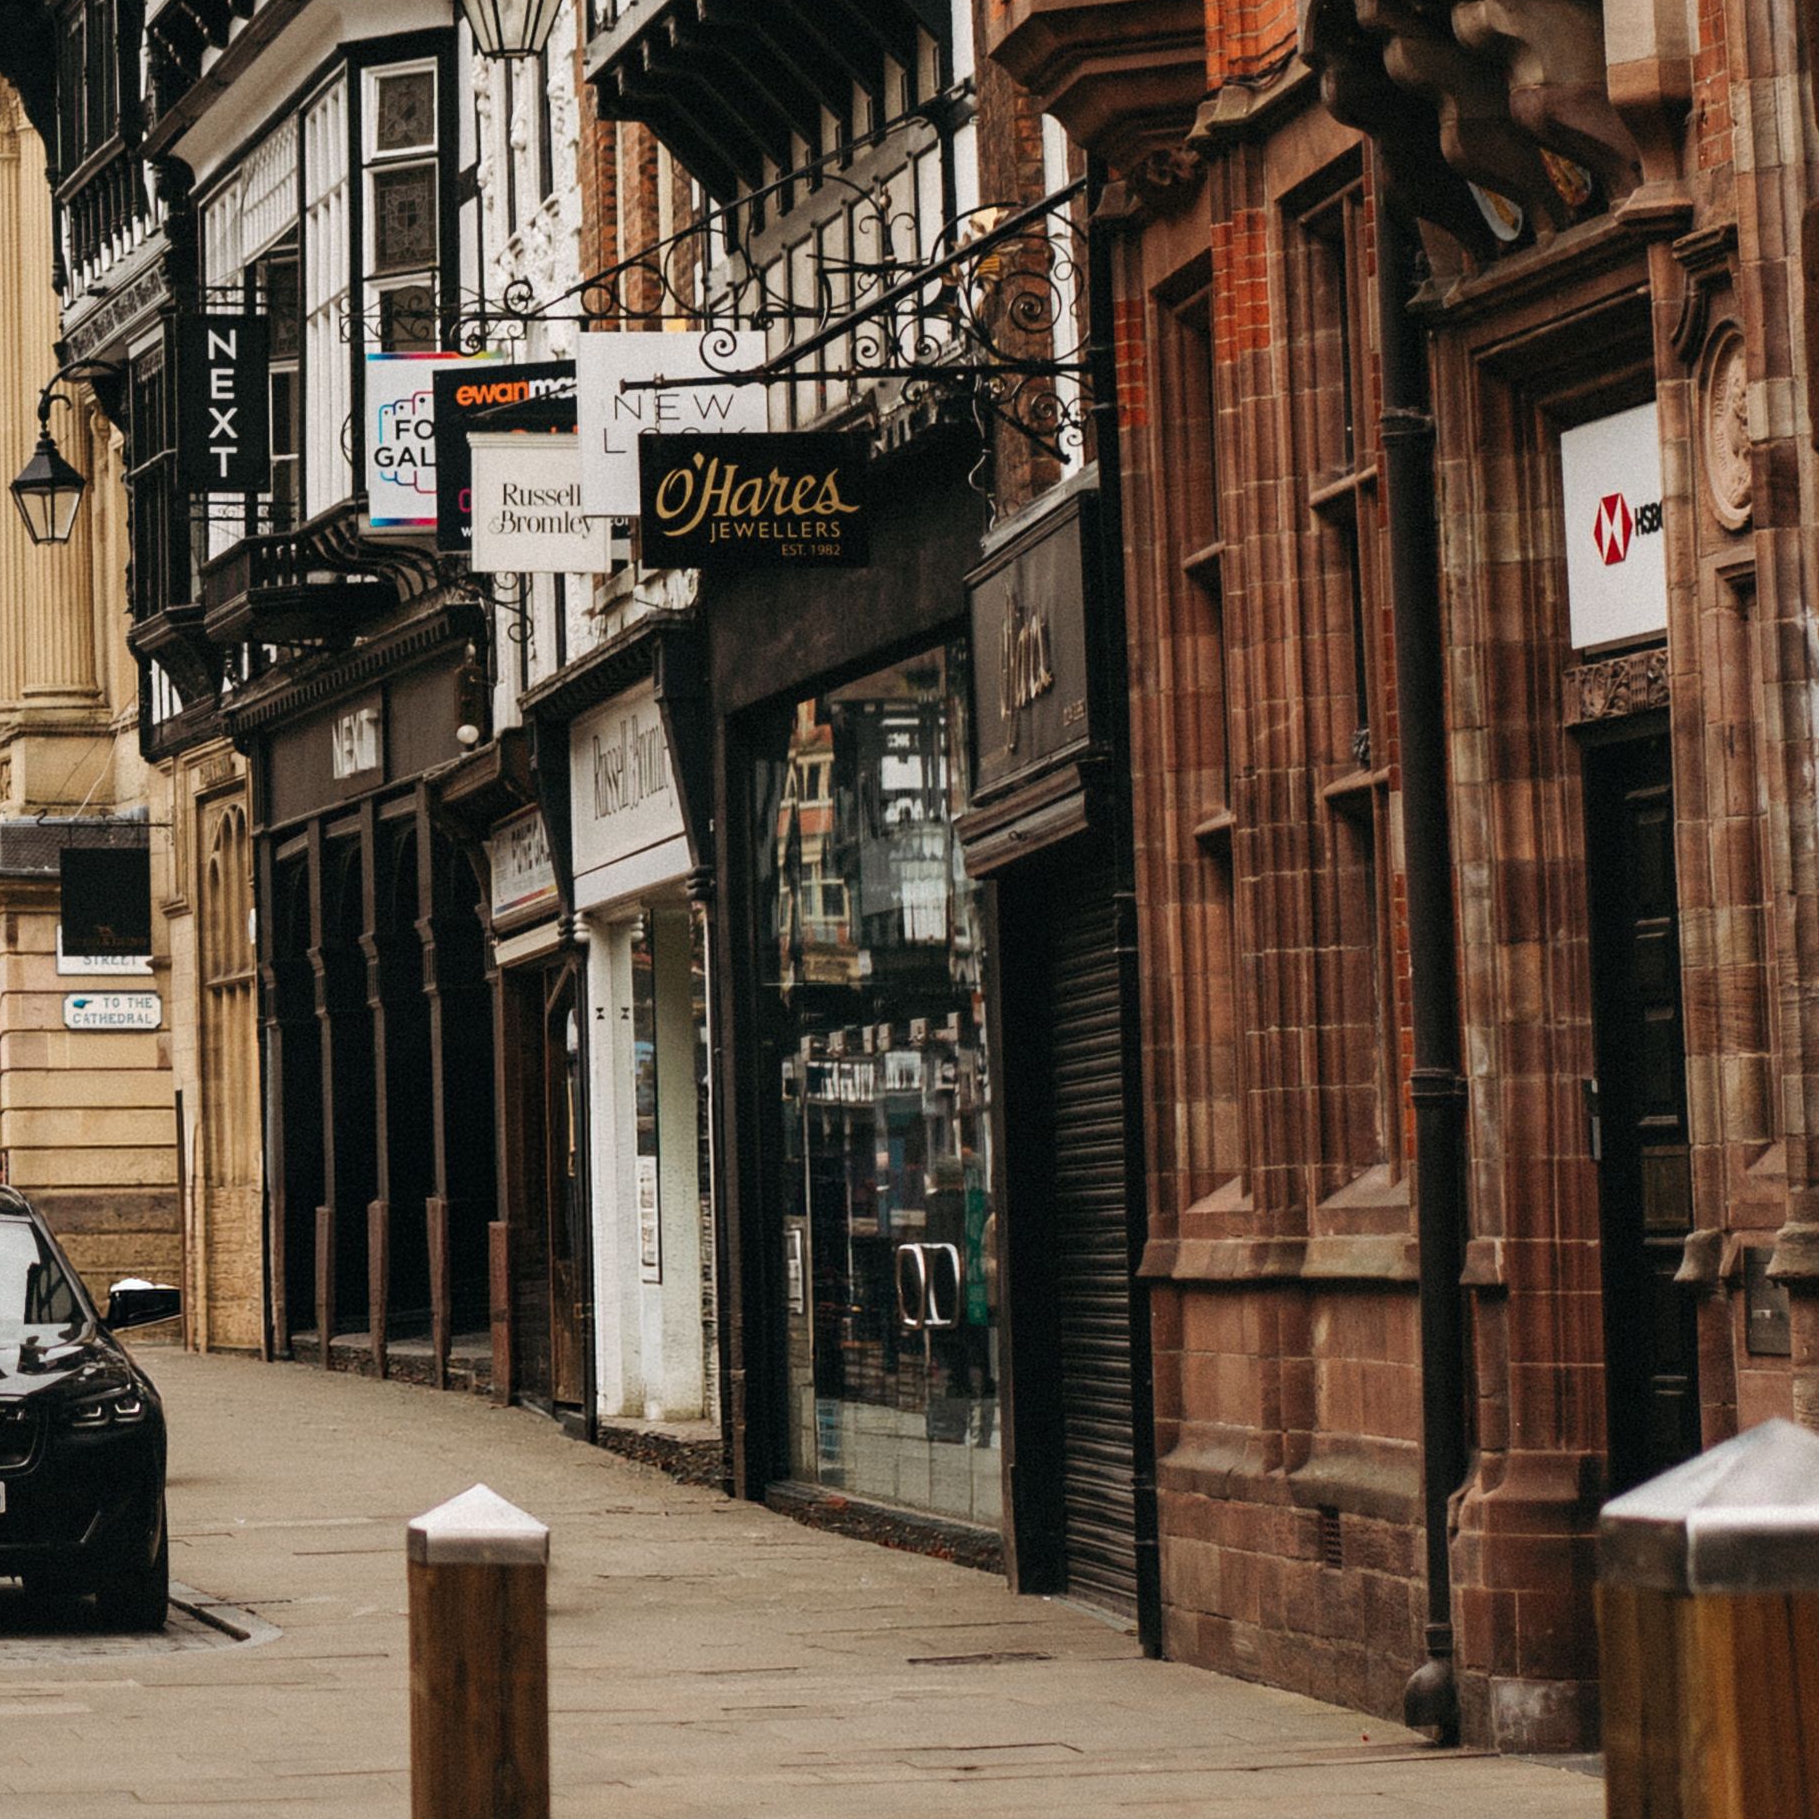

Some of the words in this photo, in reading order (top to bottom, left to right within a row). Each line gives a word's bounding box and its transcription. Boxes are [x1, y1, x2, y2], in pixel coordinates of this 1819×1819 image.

[207, 328, 239, 478] NEXT
[614, 393, 734, 421] NEW
[503, 483, 582, 508] Russell
[655, 451, 861, 538] O'Hares
[500, 510, 592, 540] Bromley
[710, 521, 841, 544] JEWELLERS
[780, 544, 807, 558] EST.
[811, 544, 841, 557] 1982
[103, 997, 121, 1009] TO
[127, 997, 153, 1009] THE
[72, 1013, 153, 1025] CATHEDRAL
